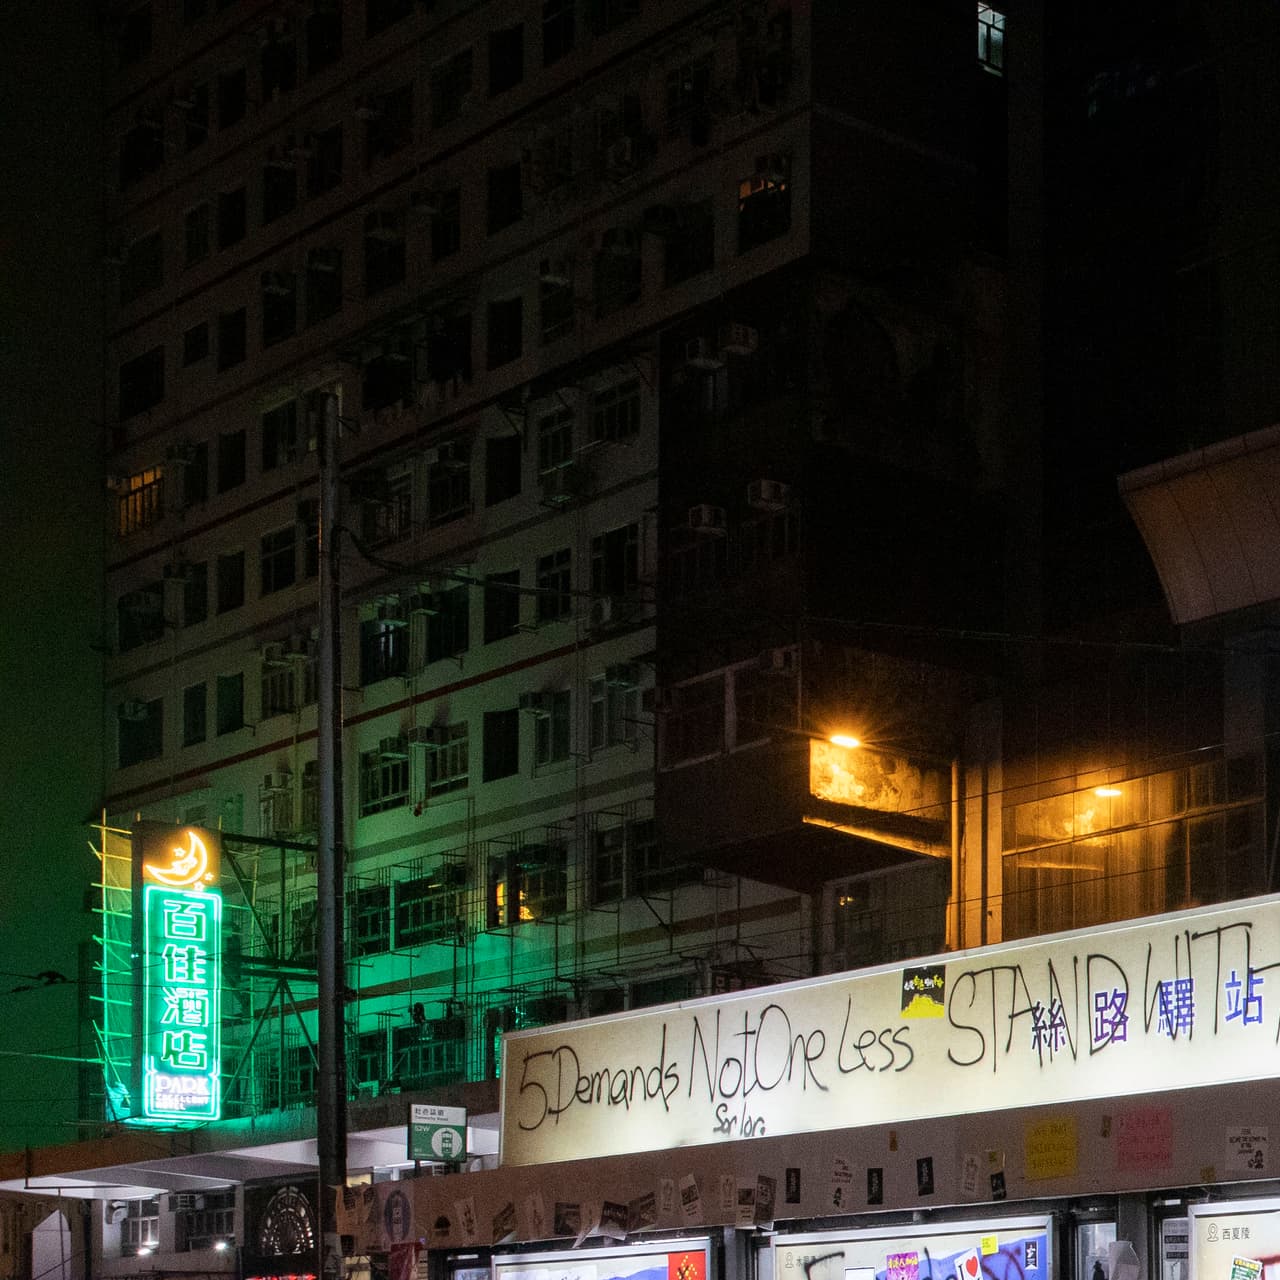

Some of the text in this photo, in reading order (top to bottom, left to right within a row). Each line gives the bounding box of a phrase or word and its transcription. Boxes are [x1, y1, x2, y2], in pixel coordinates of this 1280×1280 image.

[161, 899, 209, 1071] 百佳酒店
[838, 994, 914, 1074] Less
[948, 953, 1129, 1074] STAND
[155, 1074, 210, 1095] PARK
